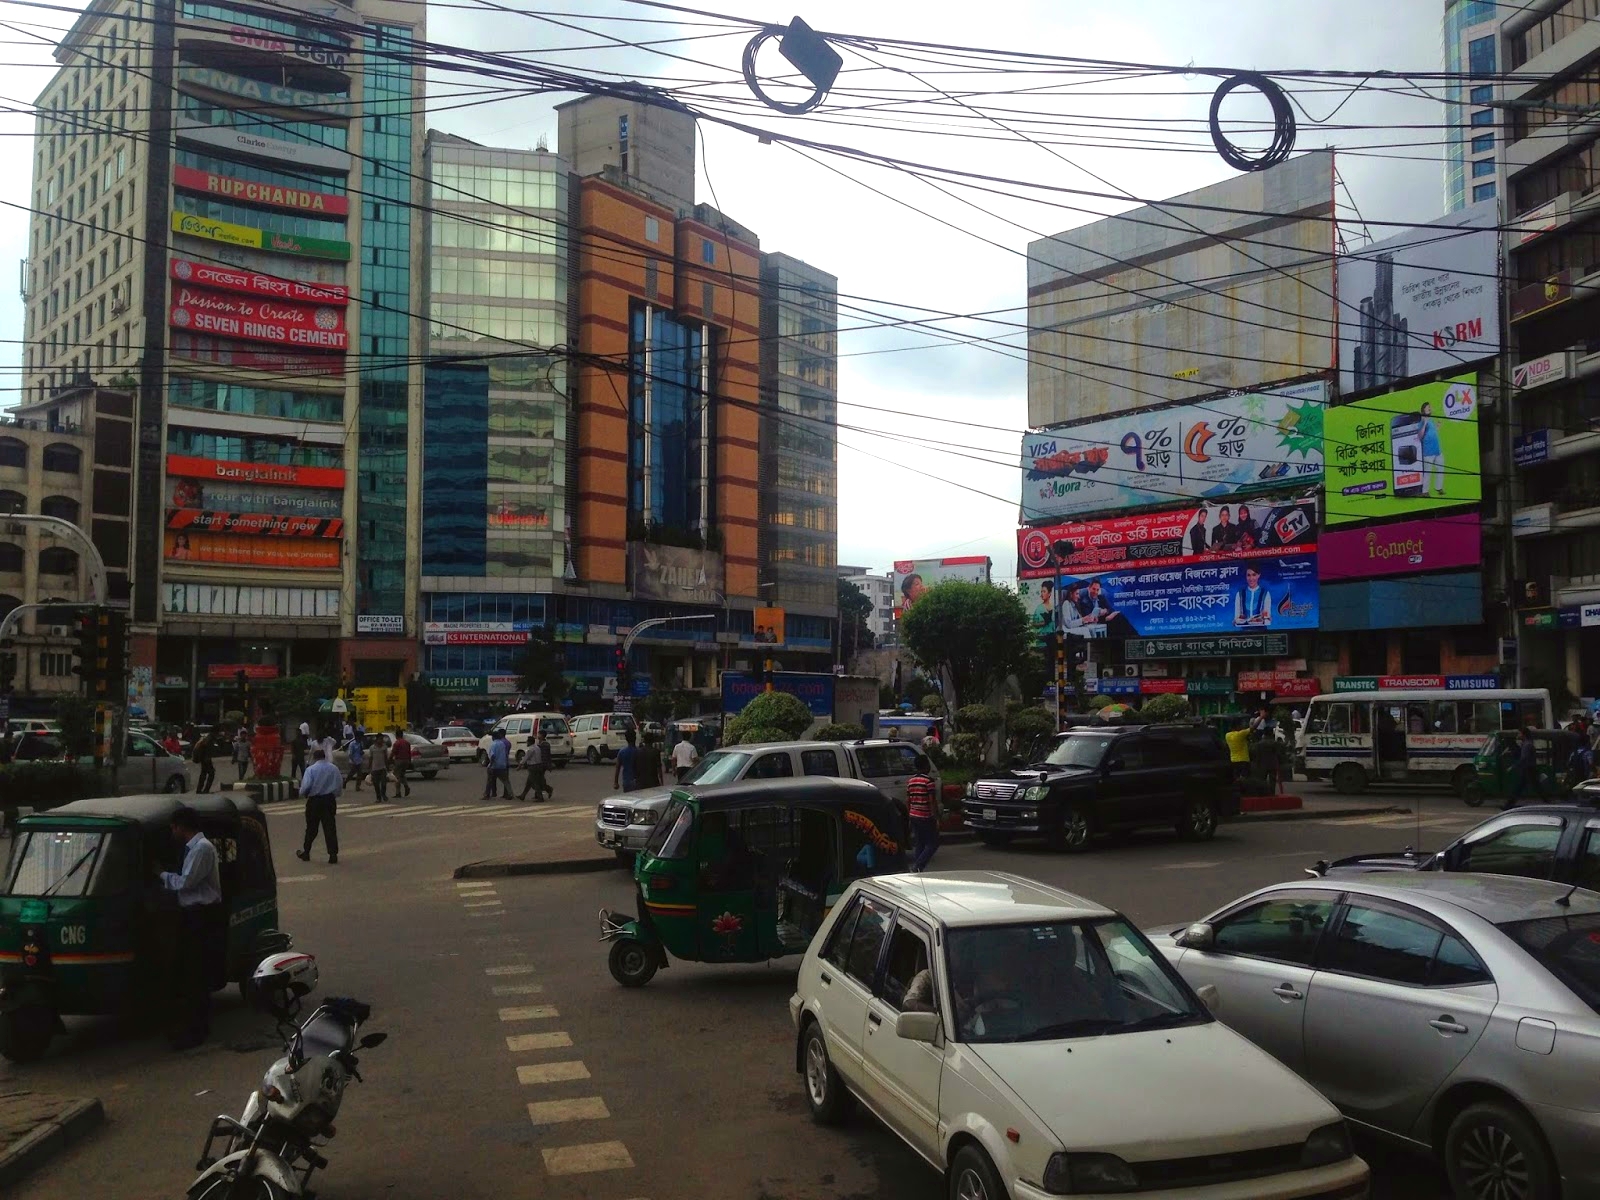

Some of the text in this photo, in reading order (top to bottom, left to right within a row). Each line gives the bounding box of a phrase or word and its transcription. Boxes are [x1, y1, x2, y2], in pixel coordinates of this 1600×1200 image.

[229, 26, 286, 51] CMA
[237, 135, 266, 148] Clarke
[207, 175, 324, 210] RUPCHANDA
[179, 288, 305, 322] Passion to Create
[195, 313, 346, 346] SEVEN RINGS CEMENT
[1433, 317, 1483, 351] KSRM
[1528, 360, 1551, 376] NDB
[1444, 388, 1474, 409] OLX
[1356, 423, 1385, 441] জিনিস
[1028, 441, 1057, 457] VISA
[215, 464, 297, 482] banglalink
[1296, 463, 1321, 474] VISA
[241, 495, 269, 504] with
[273, 496, 338, 509] banglalink
[193, 515, 318, 531] start something new
[1151, 525, 1184, 539] চলছে
[1140, 597, 1169, 613] ঢাকা
[1177, 593, 1230, 610] ব্যাংকক
[447, 633, 458, 641] KS
[460, 633, 526, 641] INTERNATIONAL
[1336, 681, 1375, 690] TRANSTEC
[1383, 679, 1440, 687] TRANSCOM
[1449, 679, 1495, 688] SAMSUNG
[60, 925, 87, 945] CNG
